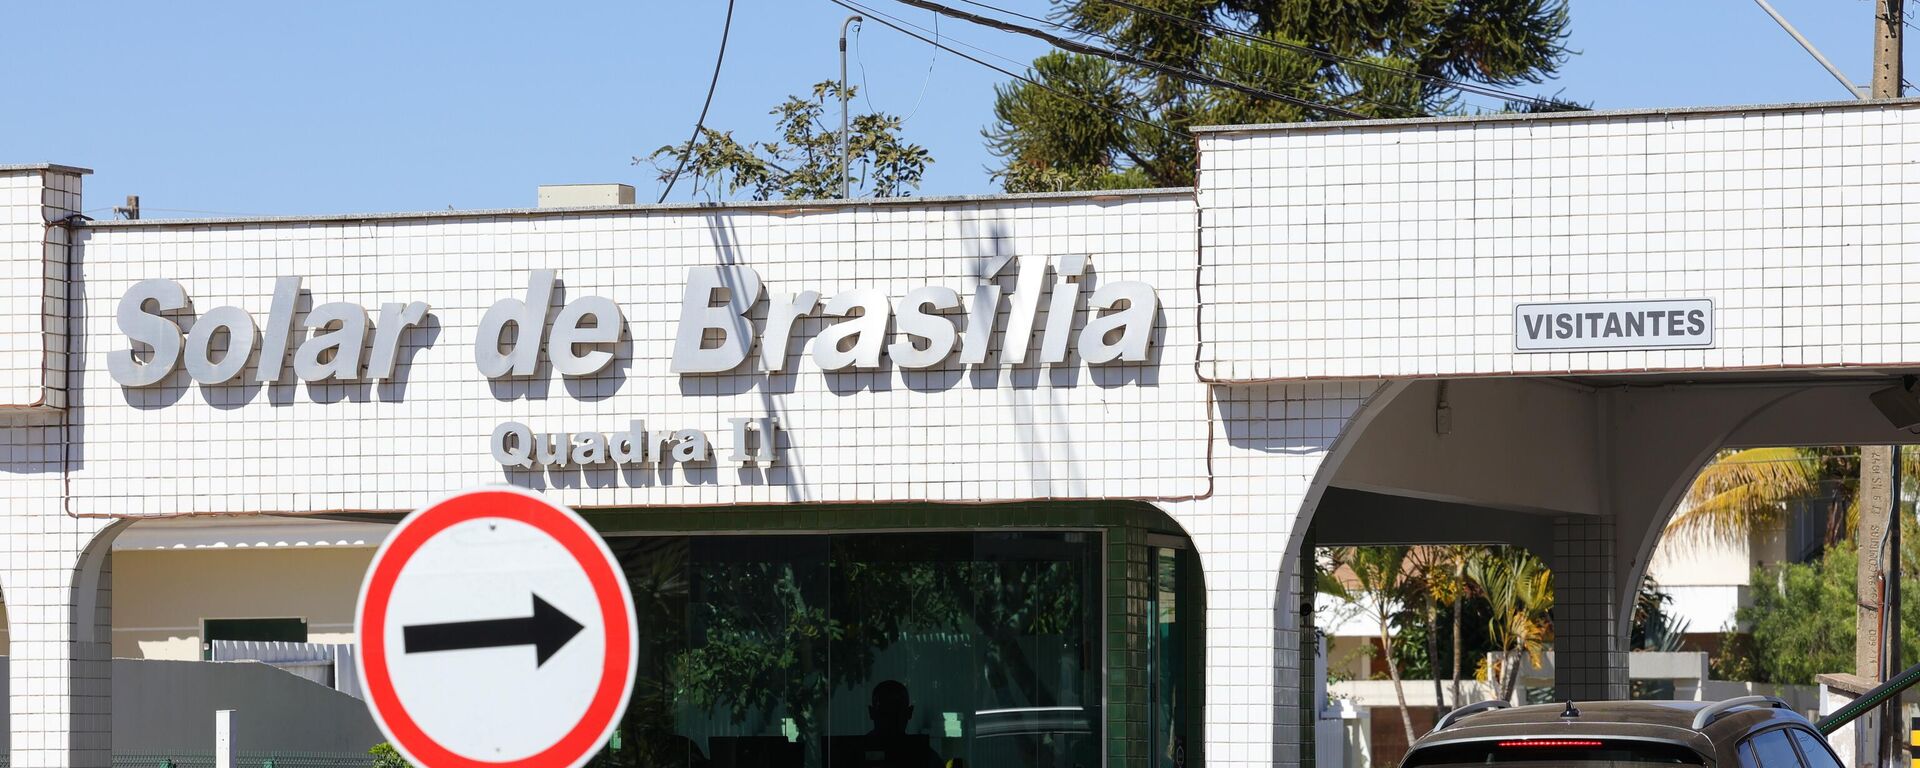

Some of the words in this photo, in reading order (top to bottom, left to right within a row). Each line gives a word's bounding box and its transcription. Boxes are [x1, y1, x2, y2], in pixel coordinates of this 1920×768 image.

[107, 276, 431, 386] Solar
[474, 269, 624, 379] de
[670, 254, 1158, 373] Brasília
[1523, 309, 1705, 340] VISITANTES
[490, 418, 709, 469] Quadra
[727, 416, 780, 462] II
